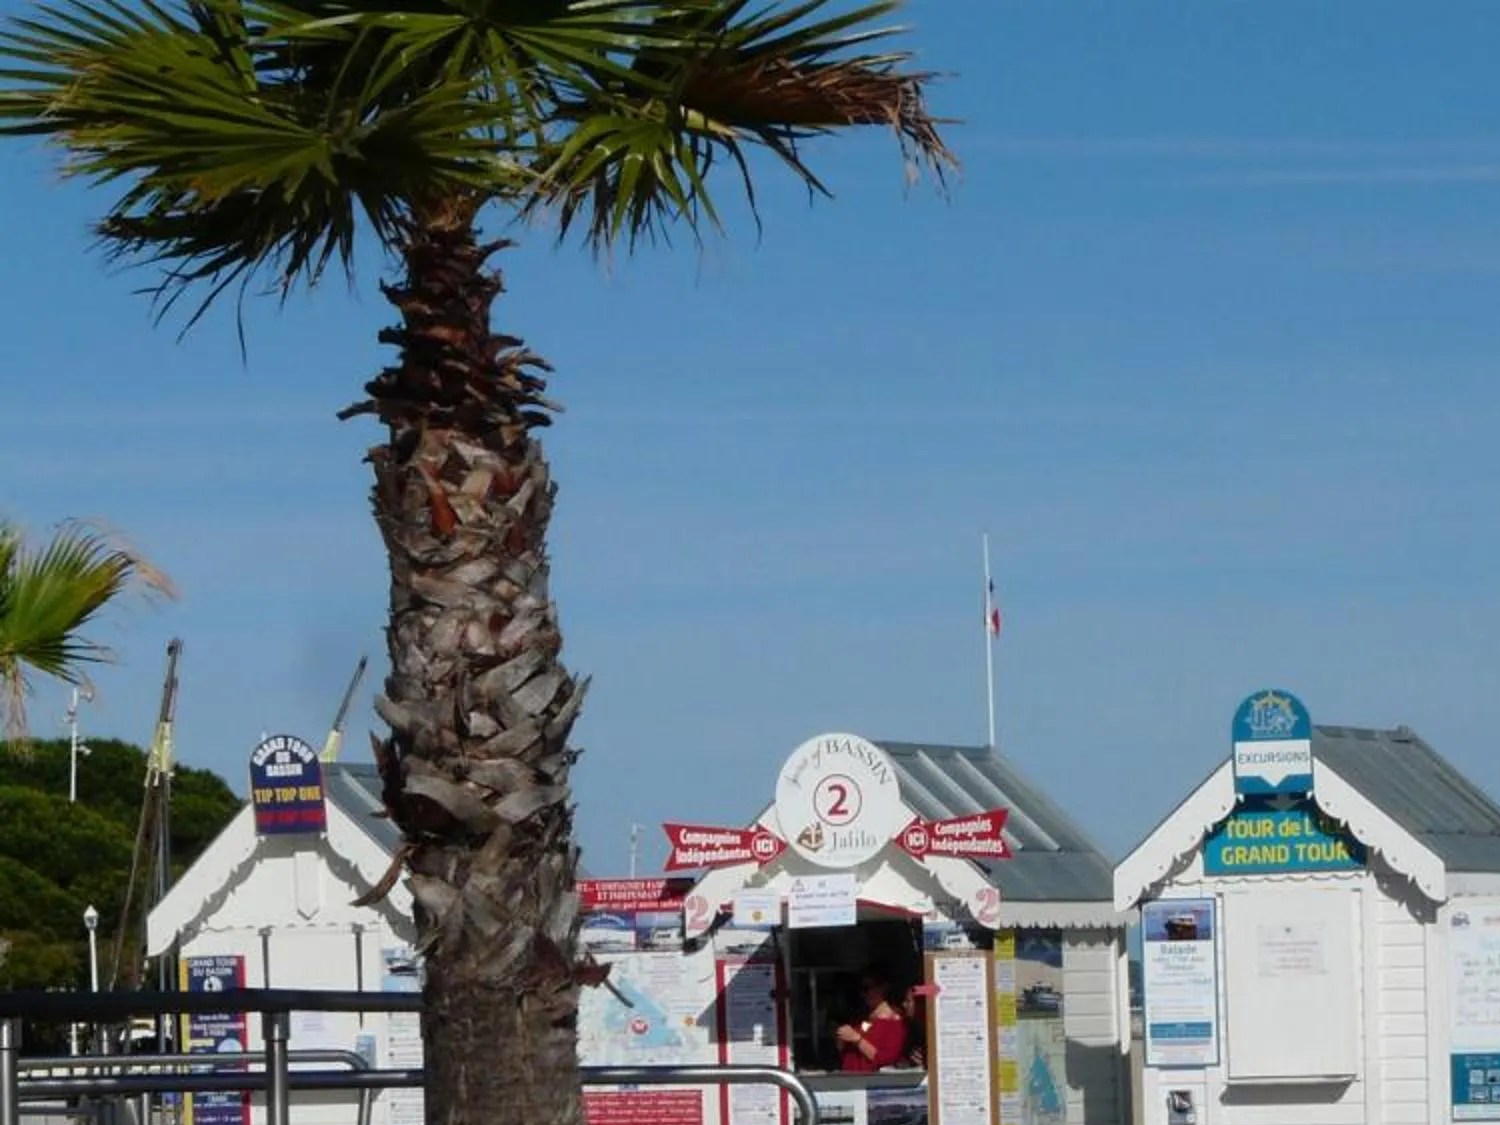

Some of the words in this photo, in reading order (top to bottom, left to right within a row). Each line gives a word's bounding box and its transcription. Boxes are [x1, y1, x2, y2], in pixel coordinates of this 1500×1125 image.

[1238, 752, 1310, 764] EXCURSIONS
[828, 784, 848, 816] 2
[1226, 817, 1275, 839] TOUR
[1279, 816, 1301, 837] de
[1221, 844, 1290, 865] GRAND
[1293, 840, 1351, 863] TOUR
